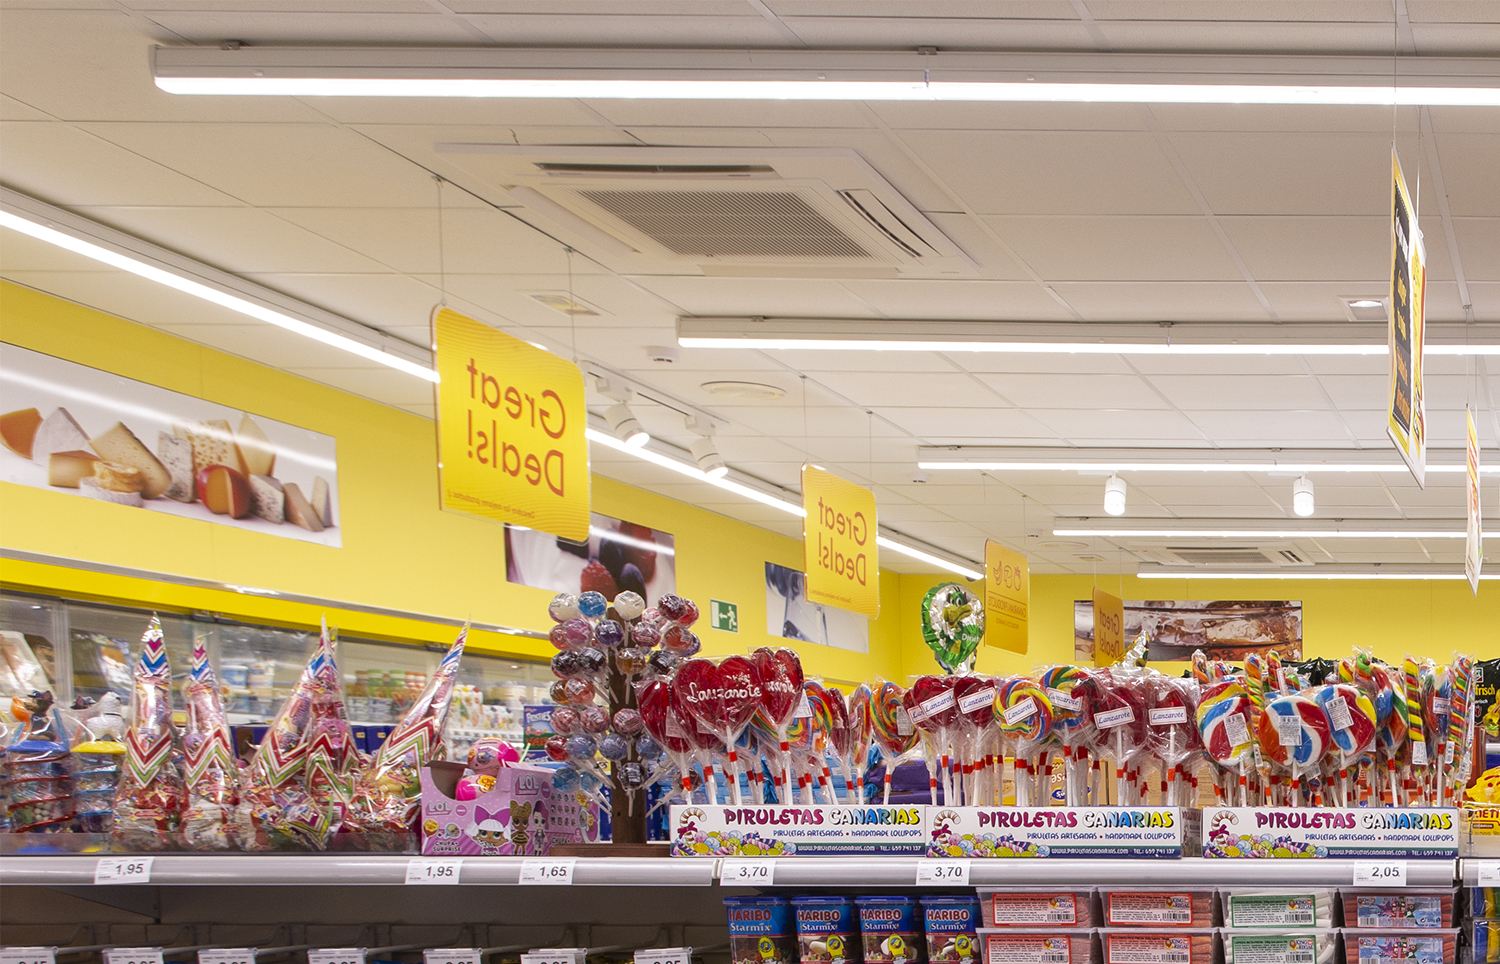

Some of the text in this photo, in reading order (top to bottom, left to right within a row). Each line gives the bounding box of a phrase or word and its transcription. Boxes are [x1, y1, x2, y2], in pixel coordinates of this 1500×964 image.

[724, 808, 920, 825] PIRULETAS CANARIAS
[977, 811, 1174, 829] PIRULETAS CANARIAS
[1255, 811, 1452, 829] PIRULETAS CANARIAS
[728, 910, 771, 922] HARIBO
[730, 921, 772, 932] Starmix
